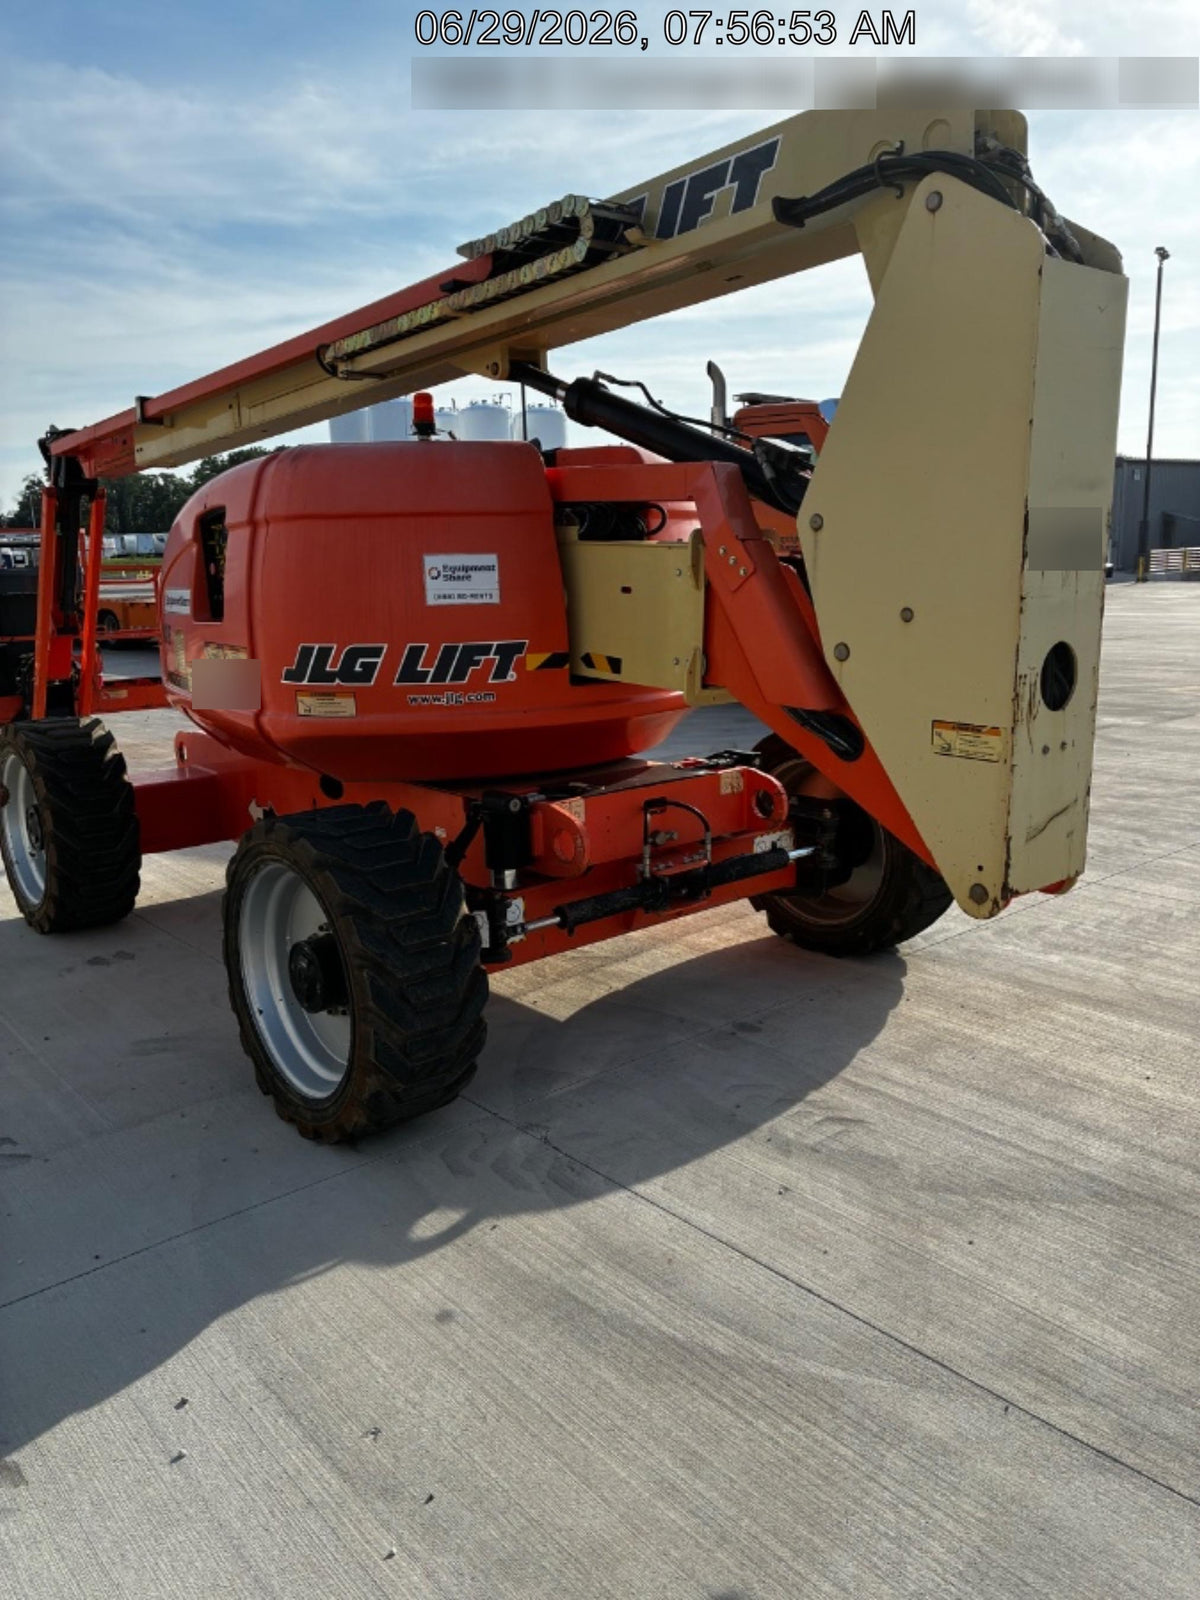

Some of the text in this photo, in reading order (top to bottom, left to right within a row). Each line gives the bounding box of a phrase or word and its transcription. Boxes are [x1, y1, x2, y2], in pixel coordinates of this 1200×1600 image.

[442, 565, 496, 574] Equipment
[442, 574, 472, 582] Share
[281, 643, 388, 685] JLG
[407, 692, 496, 705] www.jlg.com
